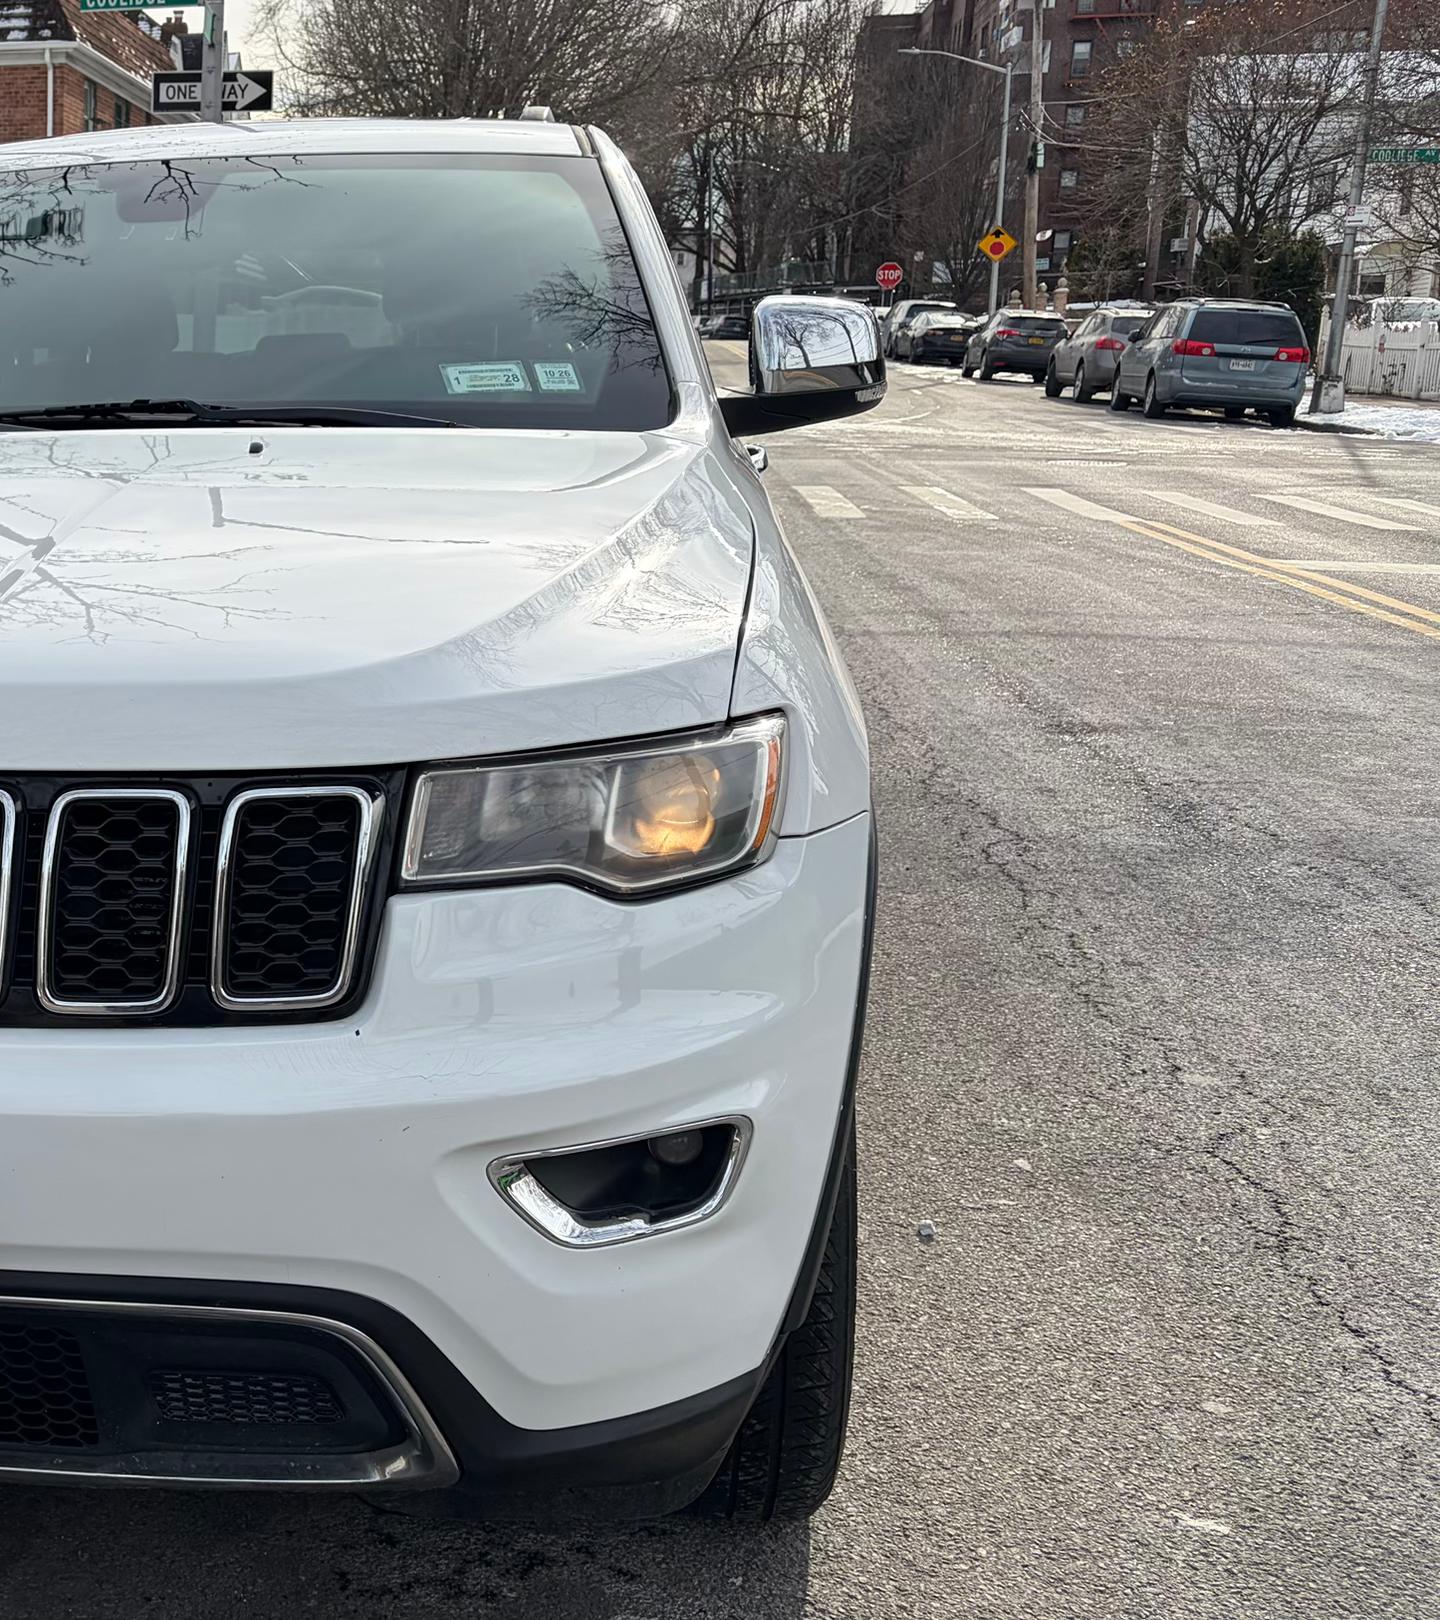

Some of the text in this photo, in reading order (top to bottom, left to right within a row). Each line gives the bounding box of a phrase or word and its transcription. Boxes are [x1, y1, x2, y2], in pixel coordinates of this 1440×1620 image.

[165, 84, 198, 100] ONE
[877, 269, 901, 280] STOP
[503, 373, 521, 384] 28
